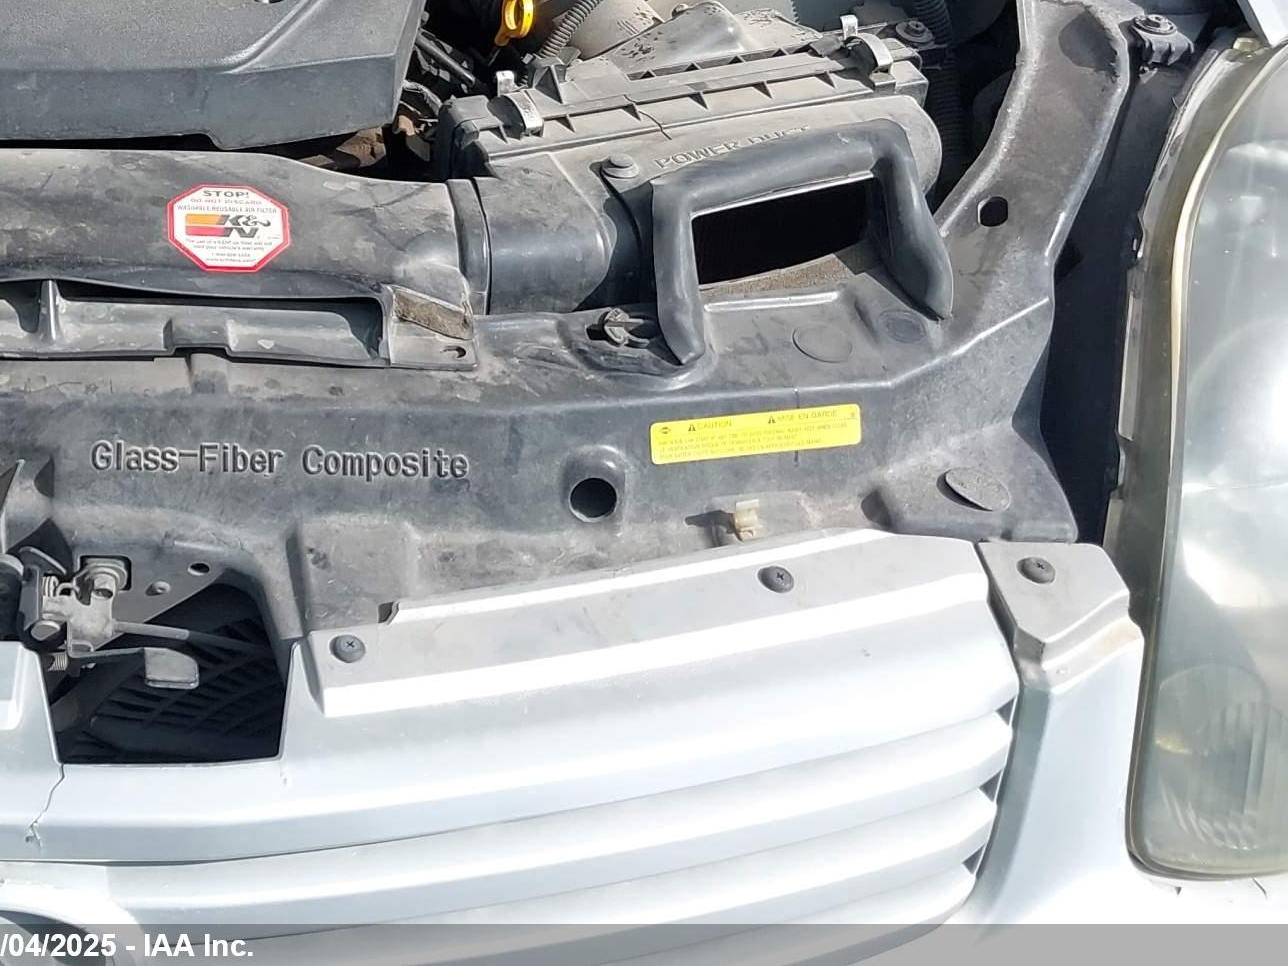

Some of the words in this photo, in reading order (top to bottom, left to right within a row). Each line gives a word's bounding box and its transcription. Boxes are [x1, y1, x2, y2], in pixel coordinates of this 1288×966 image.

[202, 190, 249, 198] STOP!
[697, 419, 732, 430] CAUTION
[91, 440, 284, 477] Glass-Fiber
[302, 445, 469, 482] Composite
